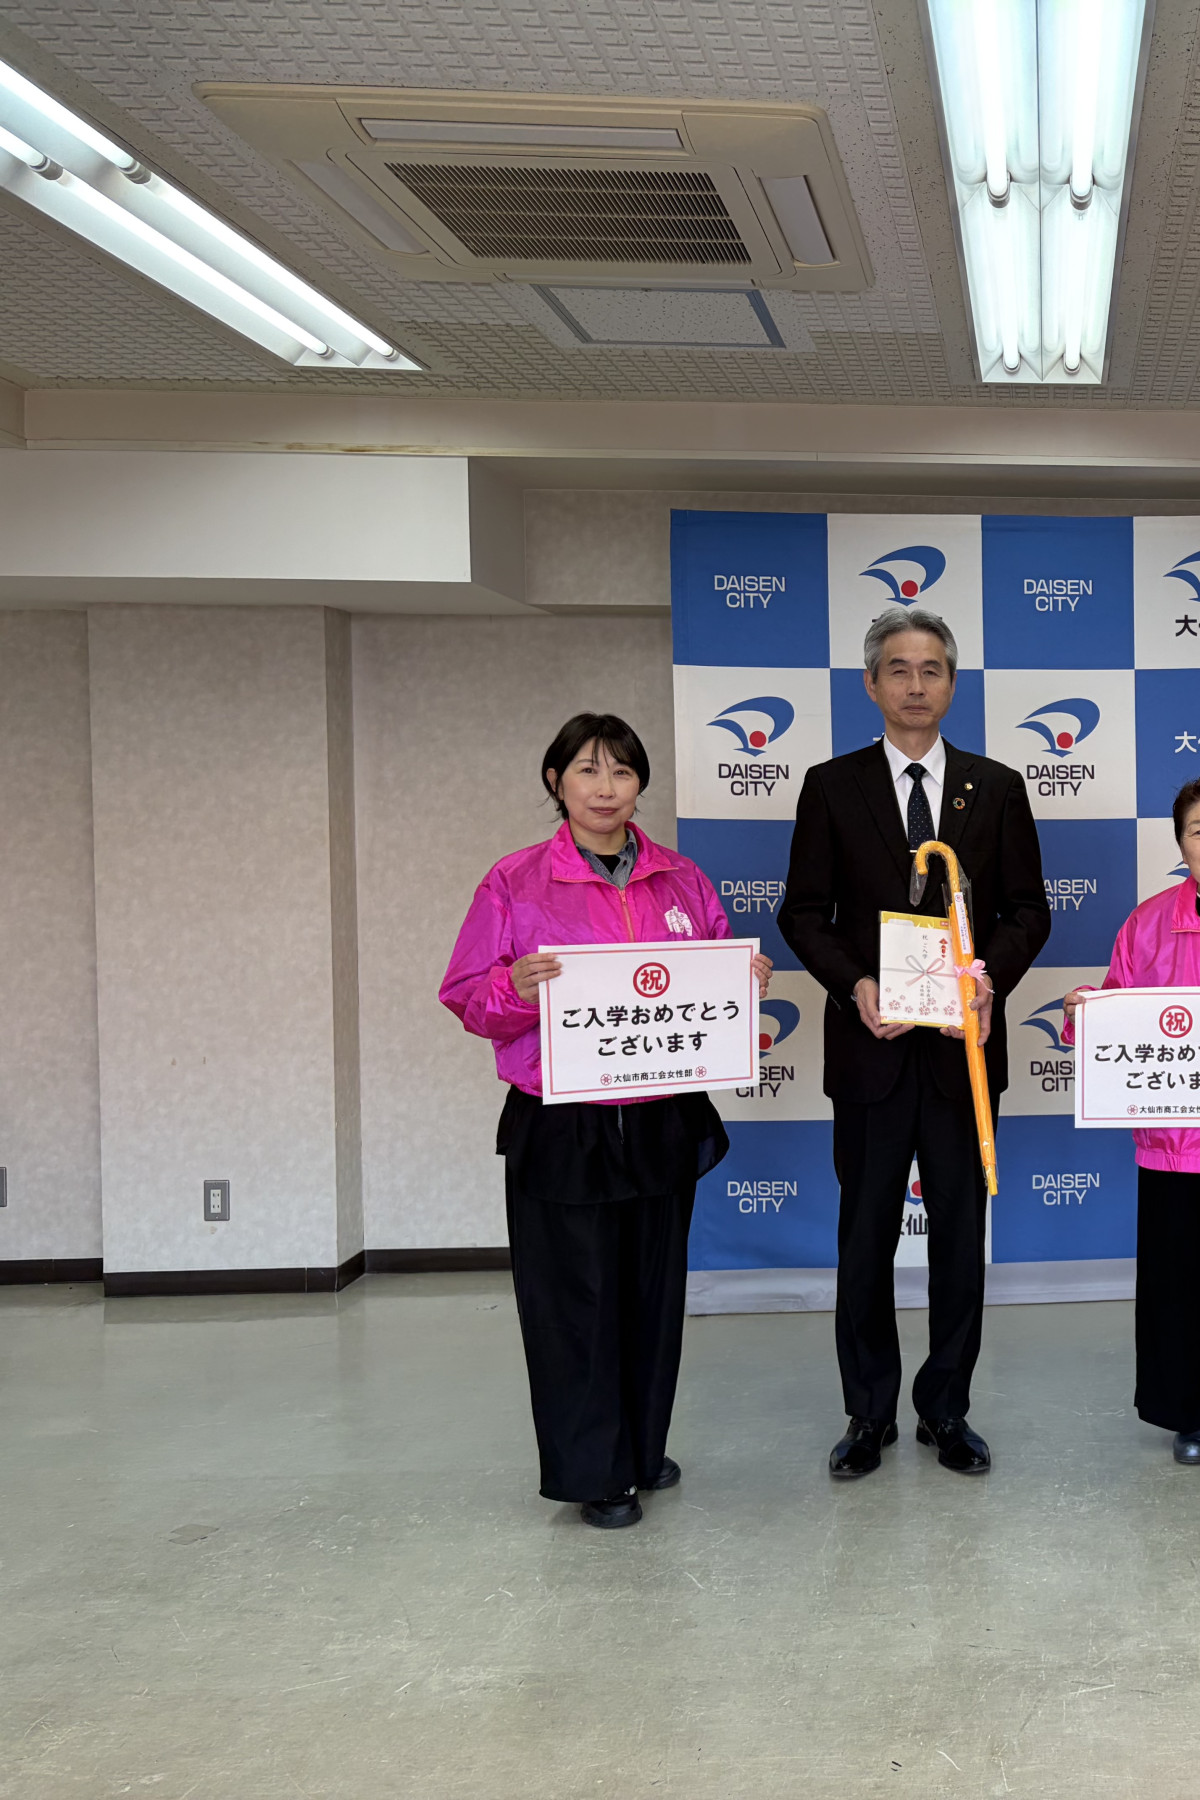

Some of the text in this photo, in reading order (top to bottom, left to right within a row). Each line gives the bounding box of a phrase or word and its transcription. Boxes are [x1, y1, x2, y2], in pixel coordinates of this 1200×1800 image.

[713, 574, 786, 592] DAISEN
[1023, 578, 1093, 596] DAISEN
[726, 593, 772, 609] CITY
[1035, 596, 1080, 612] CITY
[718, 763, 790, 780] DAISEN
[1026, 764, 1095, 780] DAISEN
[730, 780, 776, 796] CITY
[1038, 780, 1082, 796] CITY
[1044, 878, 1097, 894] AISEN
[732, 897, 779, 913] CITY
[640, 969, 663, 991] 祝
[562, 1000, 740, 1029] ご入学おめでとう
[1165, 1011, 1187, 1032] 祝
[597, 1030, 708, 1057] ございます
[613, 1068, 693, 1084] 大仙市商工会女性部
[759, 1065, 795, 1081] SEN
[1030, 1060, 1076, 1076] DAIS
[1041, 1076, 1076, 1093] CIT
[727, 1180, 798, 1198] DAISEN
[1032, 1172, 1100, 1190] DAISEN
[738, 1197, 784, 1215] CITY
[1043, 1190, 1087, 1207] CITY
